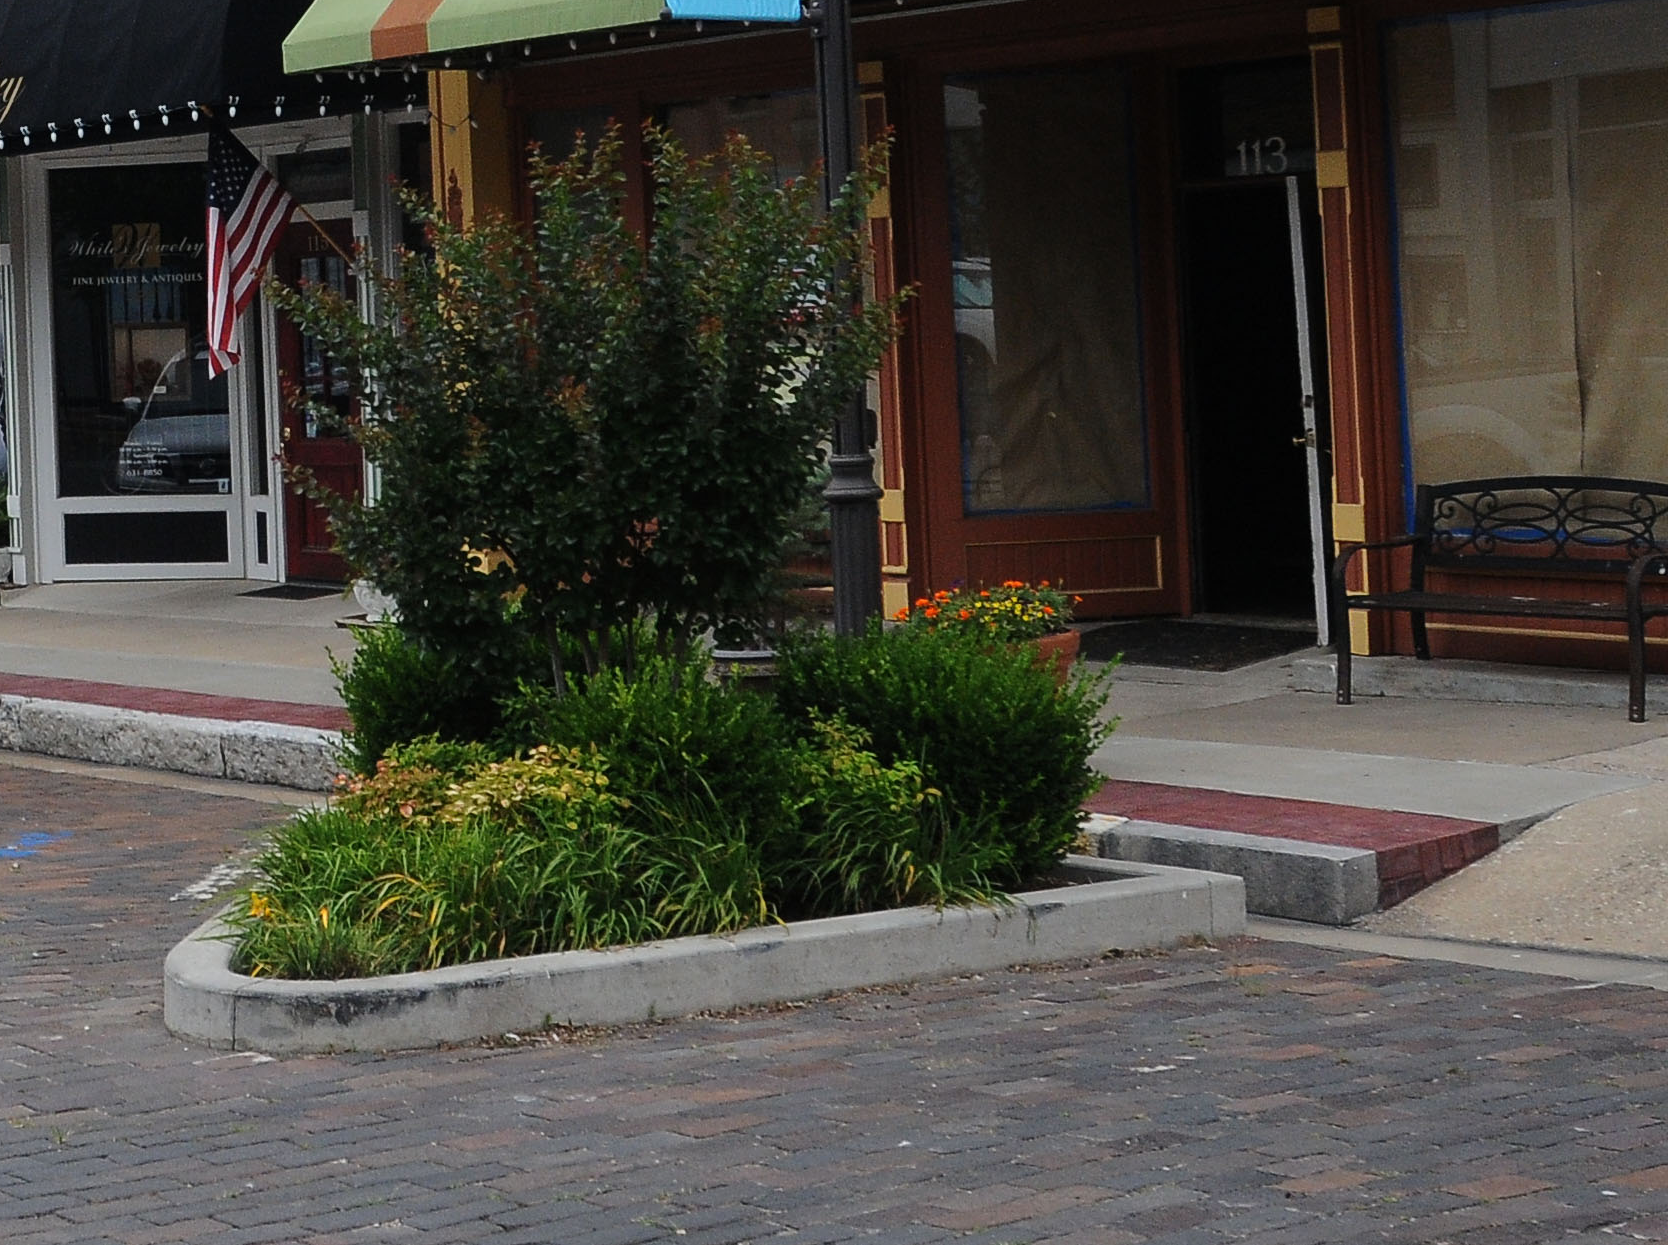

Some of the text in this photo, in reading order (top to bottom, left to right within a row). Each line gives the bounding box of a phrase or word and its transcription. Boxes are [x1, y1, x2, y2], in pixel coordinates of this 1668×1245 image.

[1235, 137, 1288, 176] 113
[73, 272, 204, 287] FINE JEWELRY & ANTIQUES
